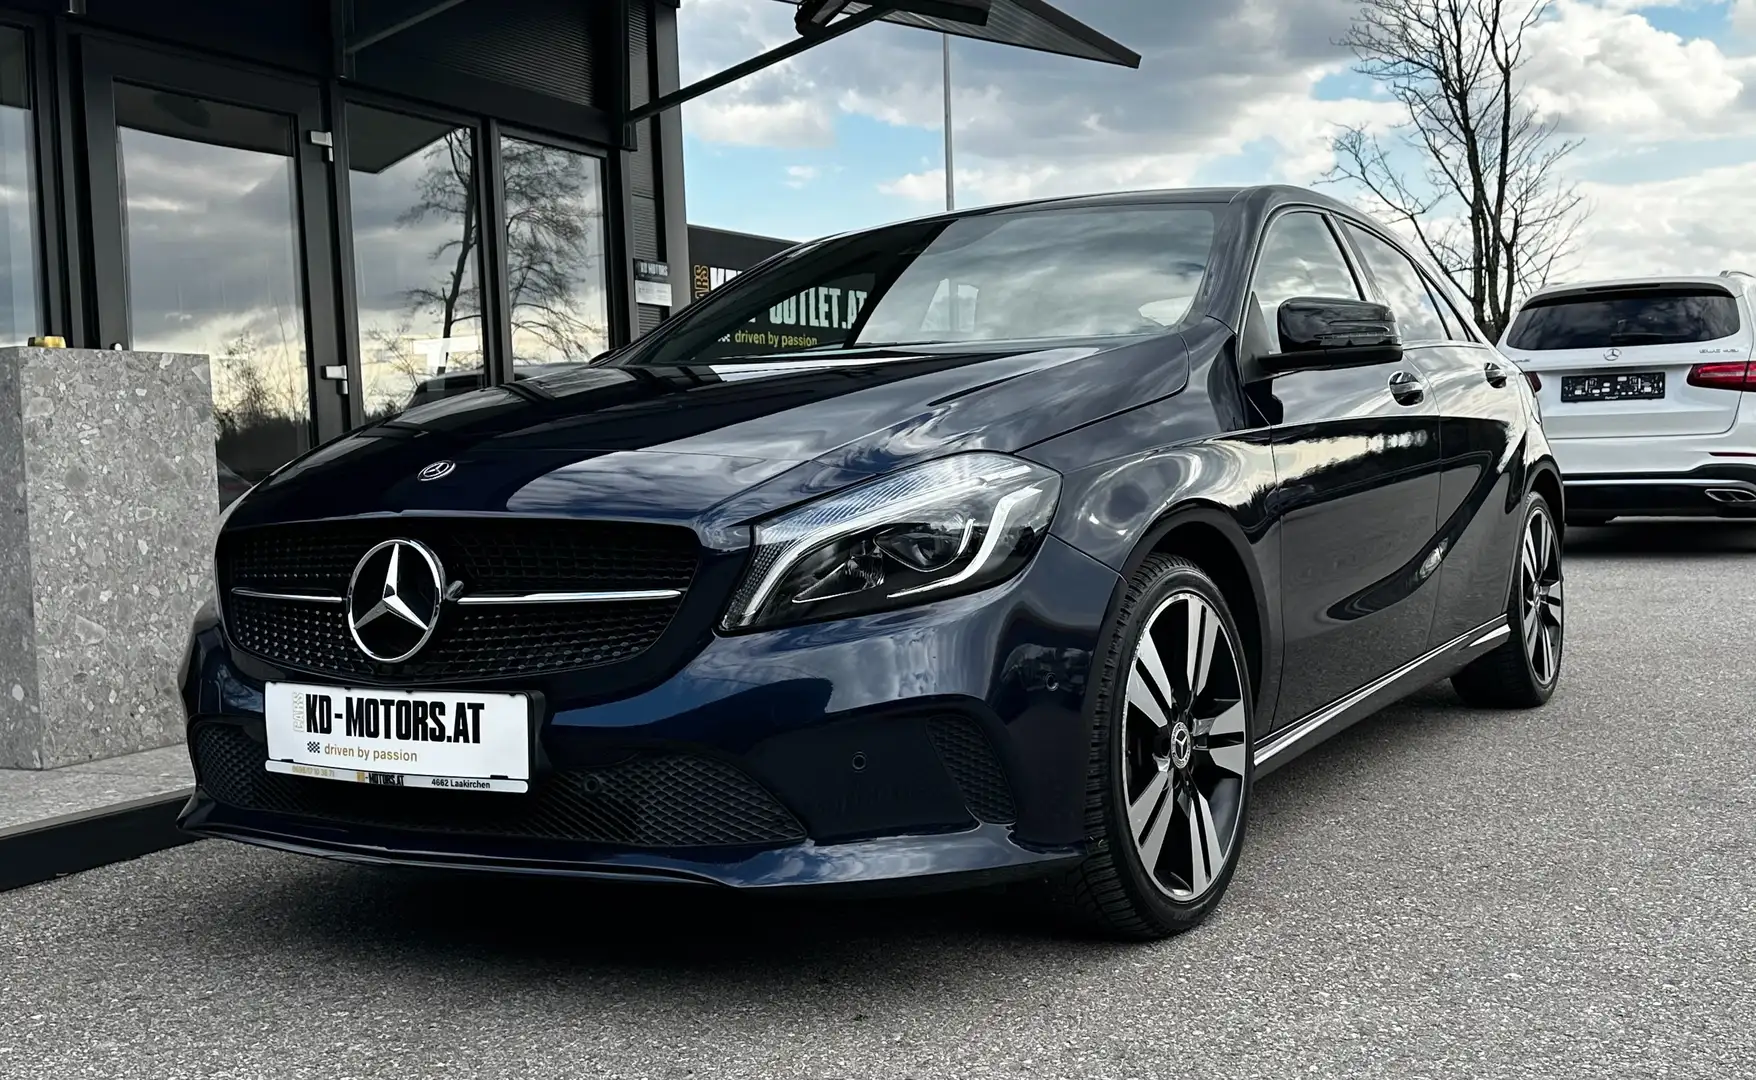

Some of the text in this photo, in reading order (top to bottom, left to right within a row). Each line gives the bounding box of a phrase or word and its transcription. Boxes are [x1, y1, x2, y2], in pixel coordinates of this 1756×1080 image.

[693, 265, 710, 300] ARS
[735, 330, 818, 348] driven by passion
[292, 691, 305, 733] CARS
[305, 693, 485, 744] KD-MOTORS.AT
[324, 743, 418, 763] driven by passion
[431, 778, 491, 789] 4662 Laakirchen
